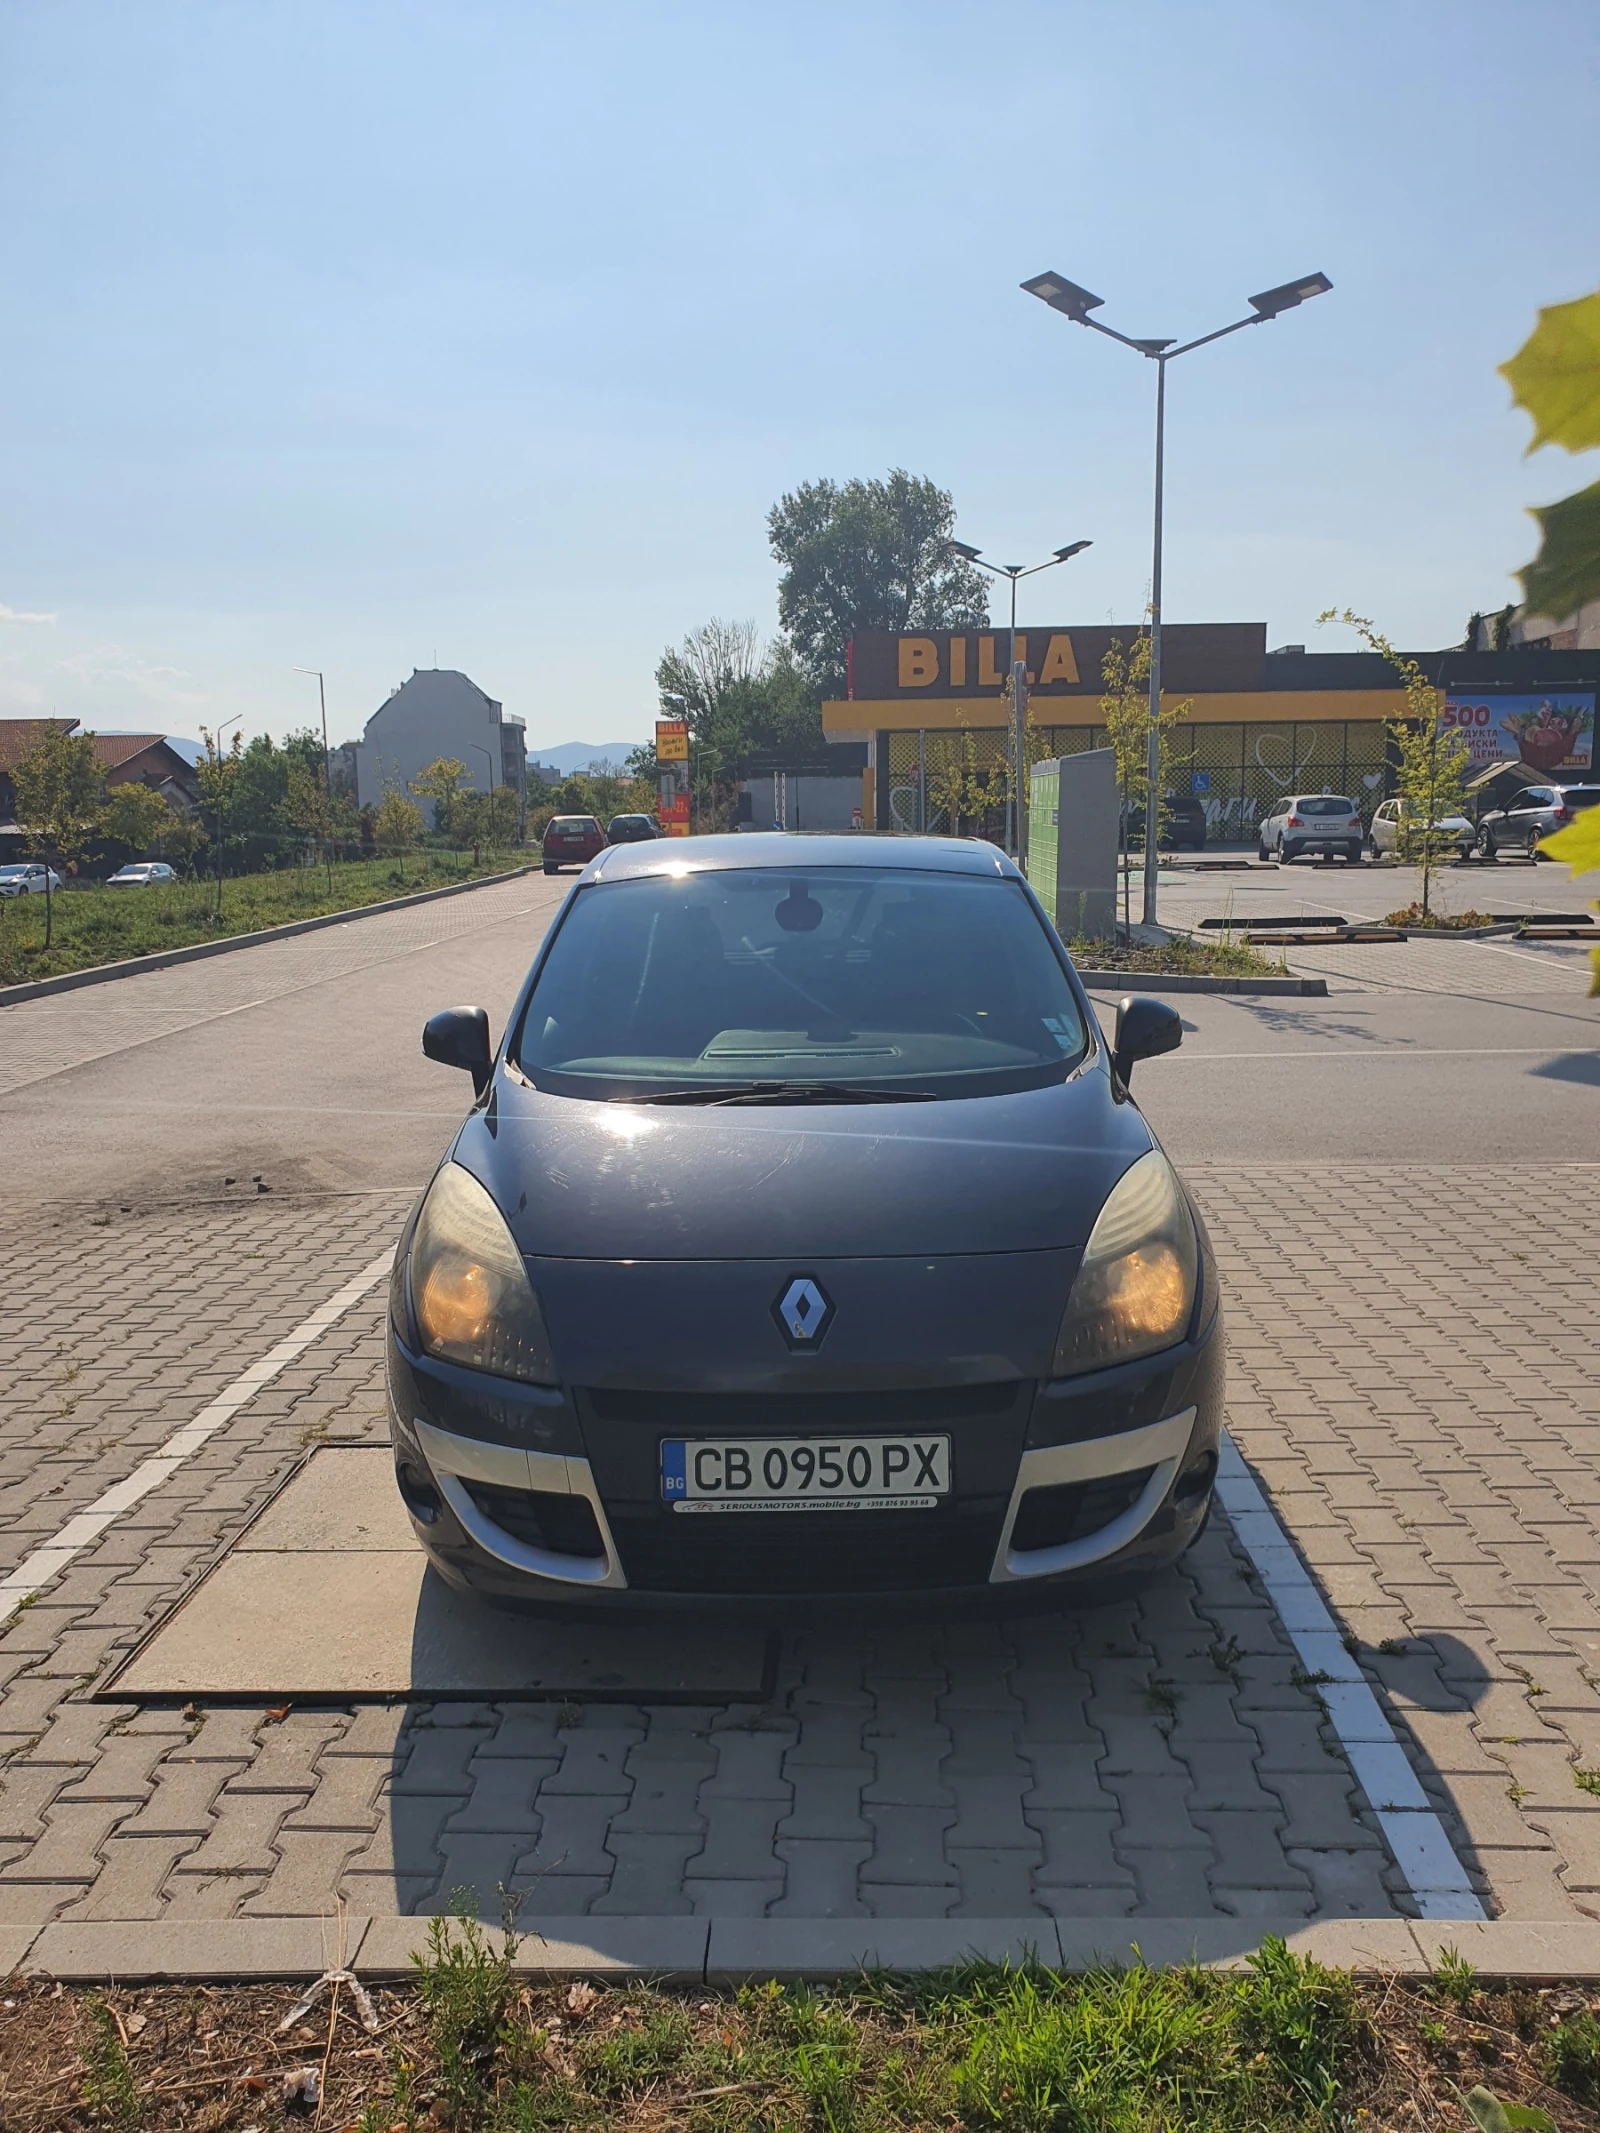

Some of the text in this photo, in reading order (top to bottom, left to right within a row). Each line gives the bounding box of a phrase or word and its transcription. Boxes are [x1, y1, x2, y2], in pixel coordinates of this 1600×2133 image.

[898, 634, 1080, 688] BILLA
[1442, 705, 1491, 727] 500
[659, 723, 685, 733] BILLA
[1442, 729, 1498, 739] ПОДУКТА
[1473, 749, 1503, 759] ЦЕНИ
[694, 1443, 940, 1491] CB 0950 PX
[666, 1476, 684, 1490] BG
[719, 1500, 861, 1511] SERIOUSMOTORS.mobile.bg
